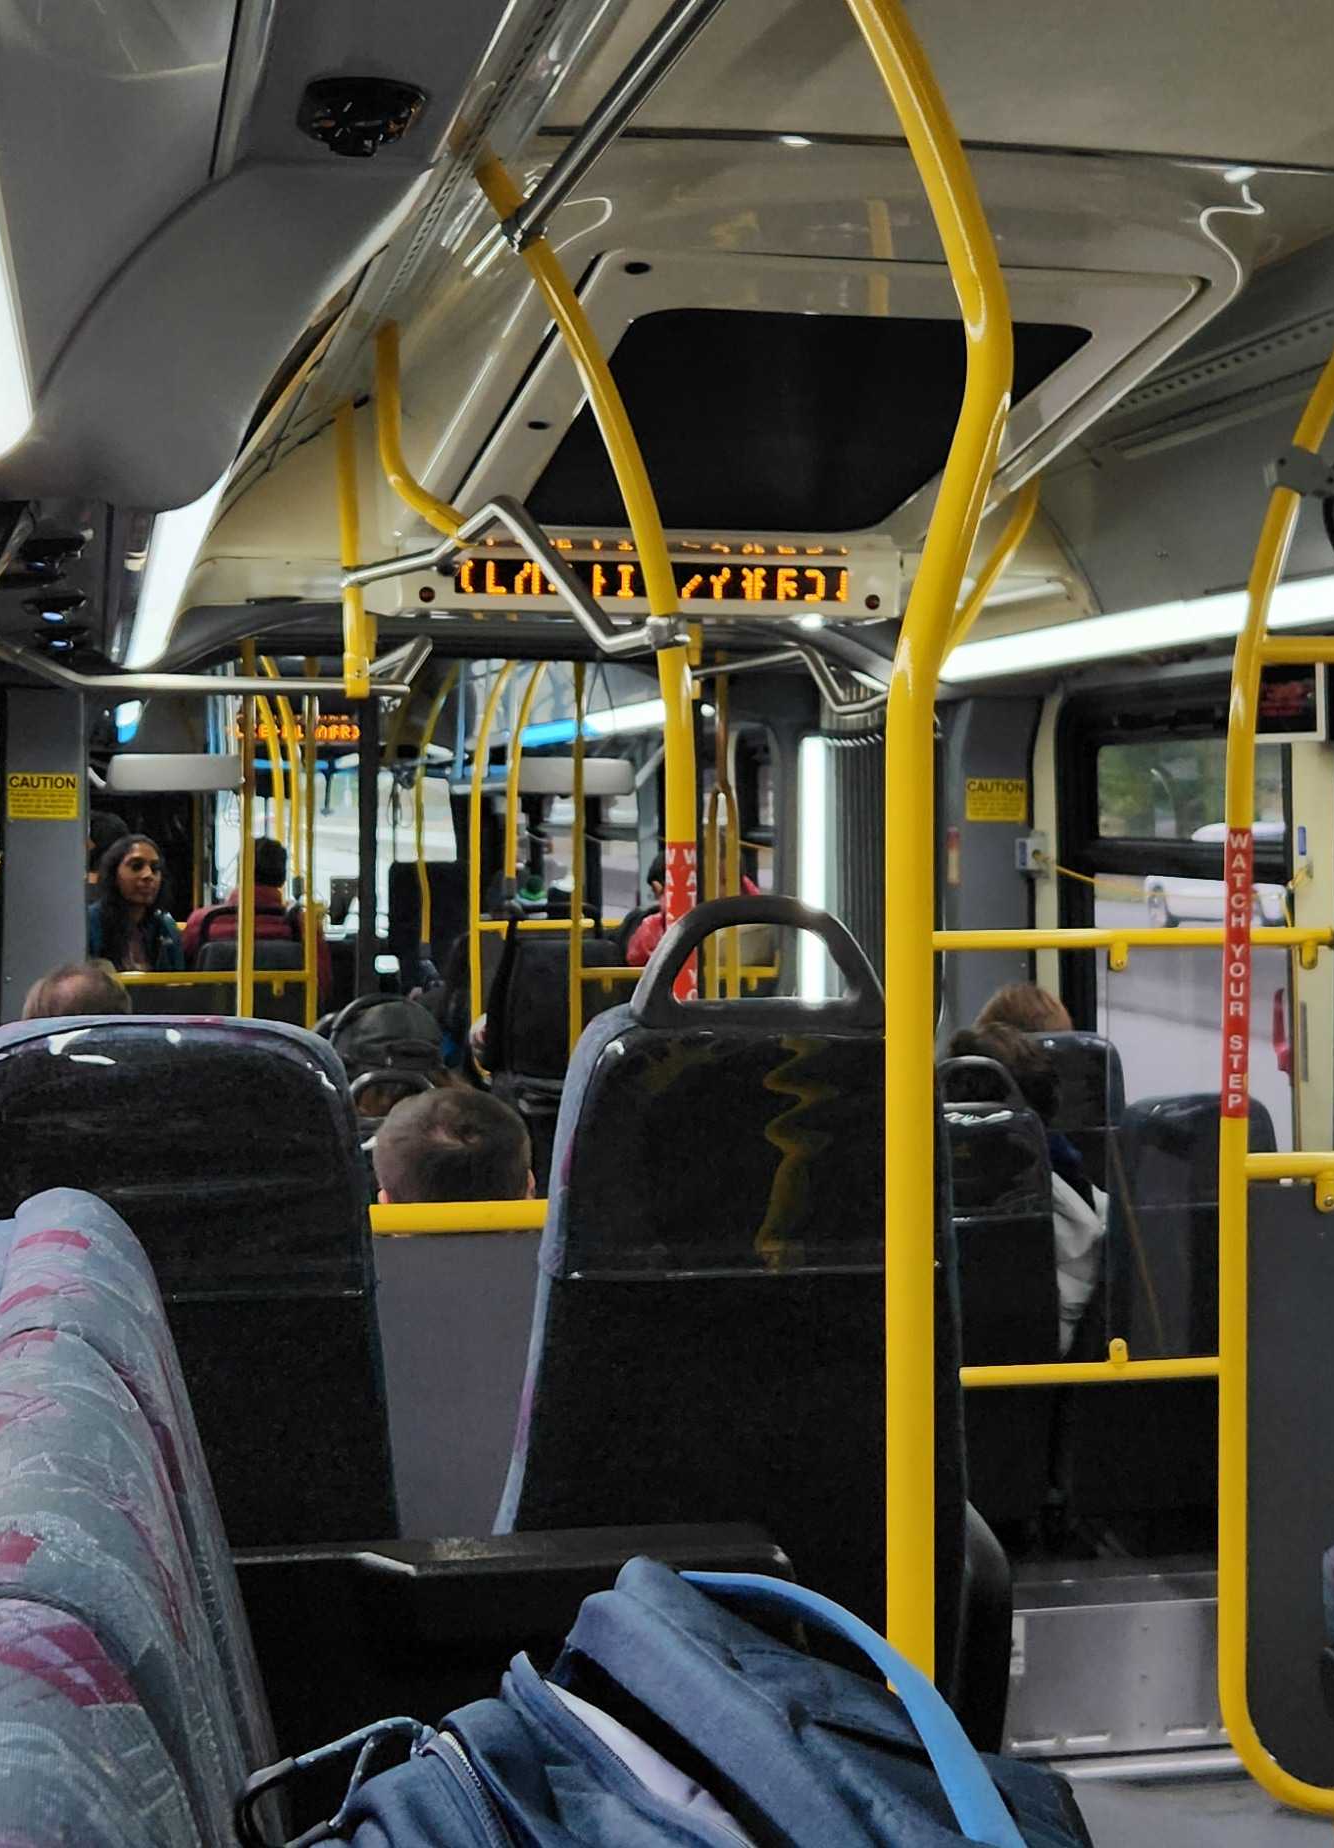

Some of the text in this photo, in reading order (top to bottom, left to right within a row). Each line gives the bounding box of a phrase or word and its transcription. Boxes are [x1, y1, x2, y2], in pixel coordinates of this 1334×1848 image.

[10, 776, 75, 788] CAUTION
[968, 782, 1023, 794] CAUTION
[1228, 832, 1250, 1109] WATCH YOUR STEP
